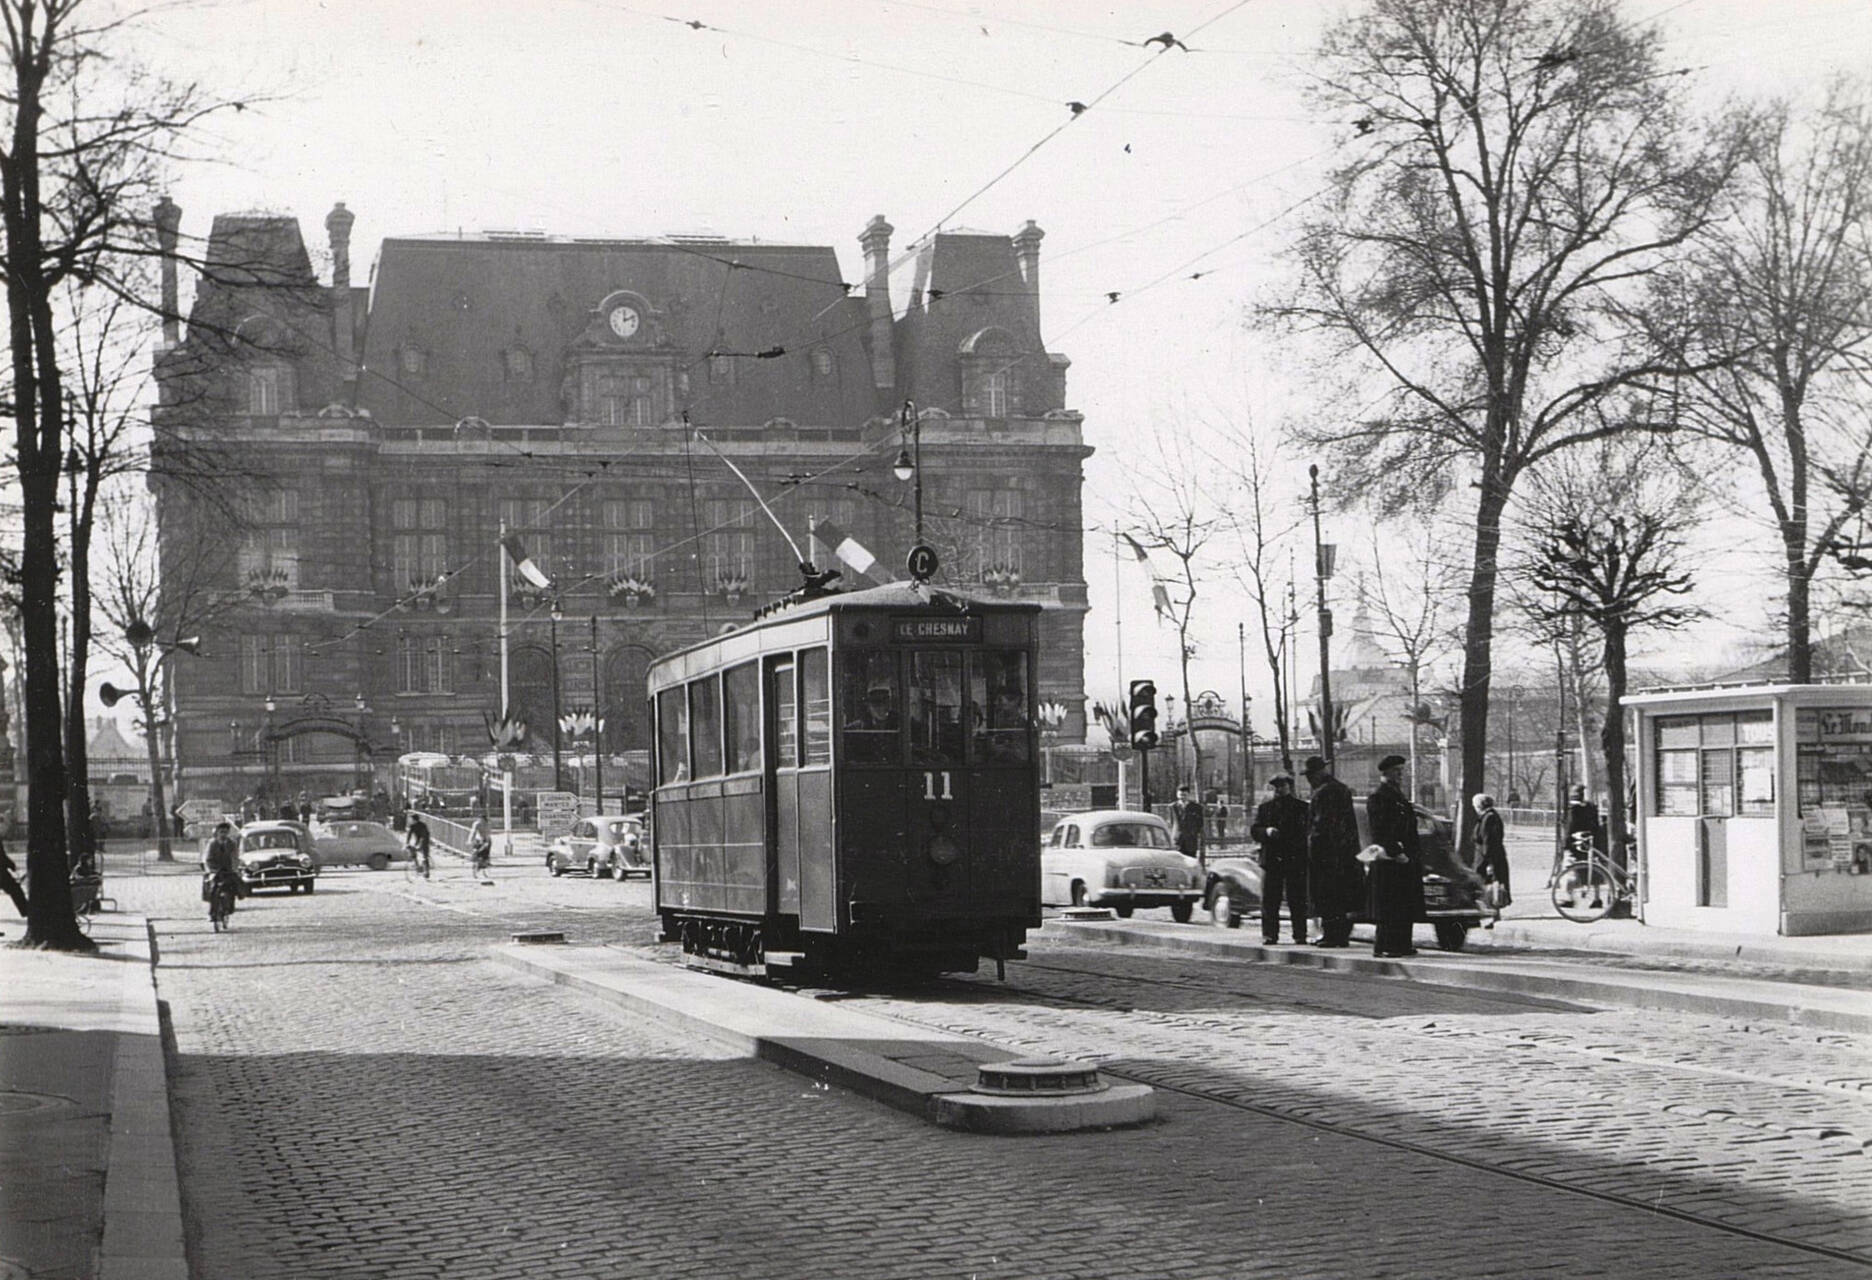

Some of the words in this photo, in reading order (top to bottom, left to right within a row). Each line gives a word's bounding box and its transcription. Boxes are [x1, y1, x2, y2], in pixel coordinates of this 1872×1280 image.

[917, 551, 929, 573] C
[900, 624, 913, 636] LE
[918, 623, 968, 635] CHESNAY
[1838, 712, 1872, 735] Mon
[924, 771, 953, 800] 11
